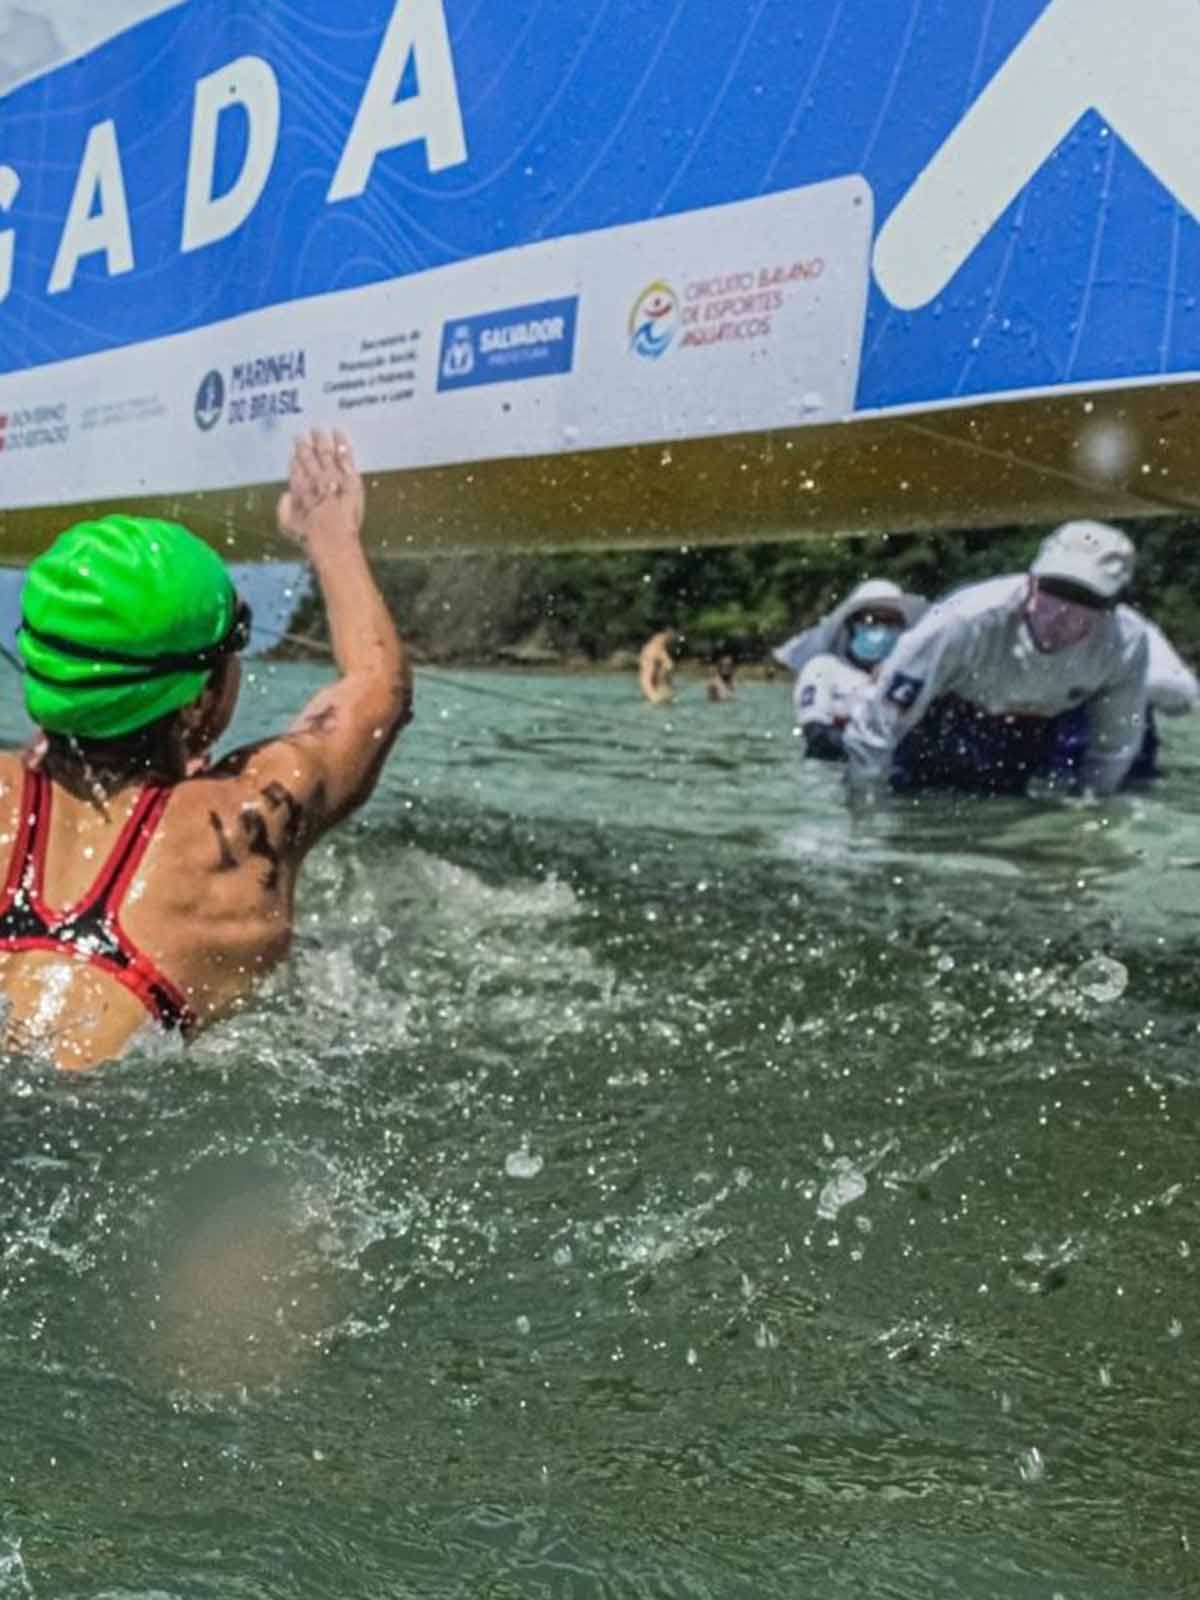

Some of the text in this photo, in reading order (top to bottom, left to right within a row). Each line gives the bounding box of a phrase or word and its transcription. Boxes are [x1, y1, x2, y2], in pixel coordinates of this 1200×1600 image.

[480, 316, 565, 354] SALVADOR
[230, 350, 306, 393] MARINHA
[249, 388, 303, 422] BRASIL
